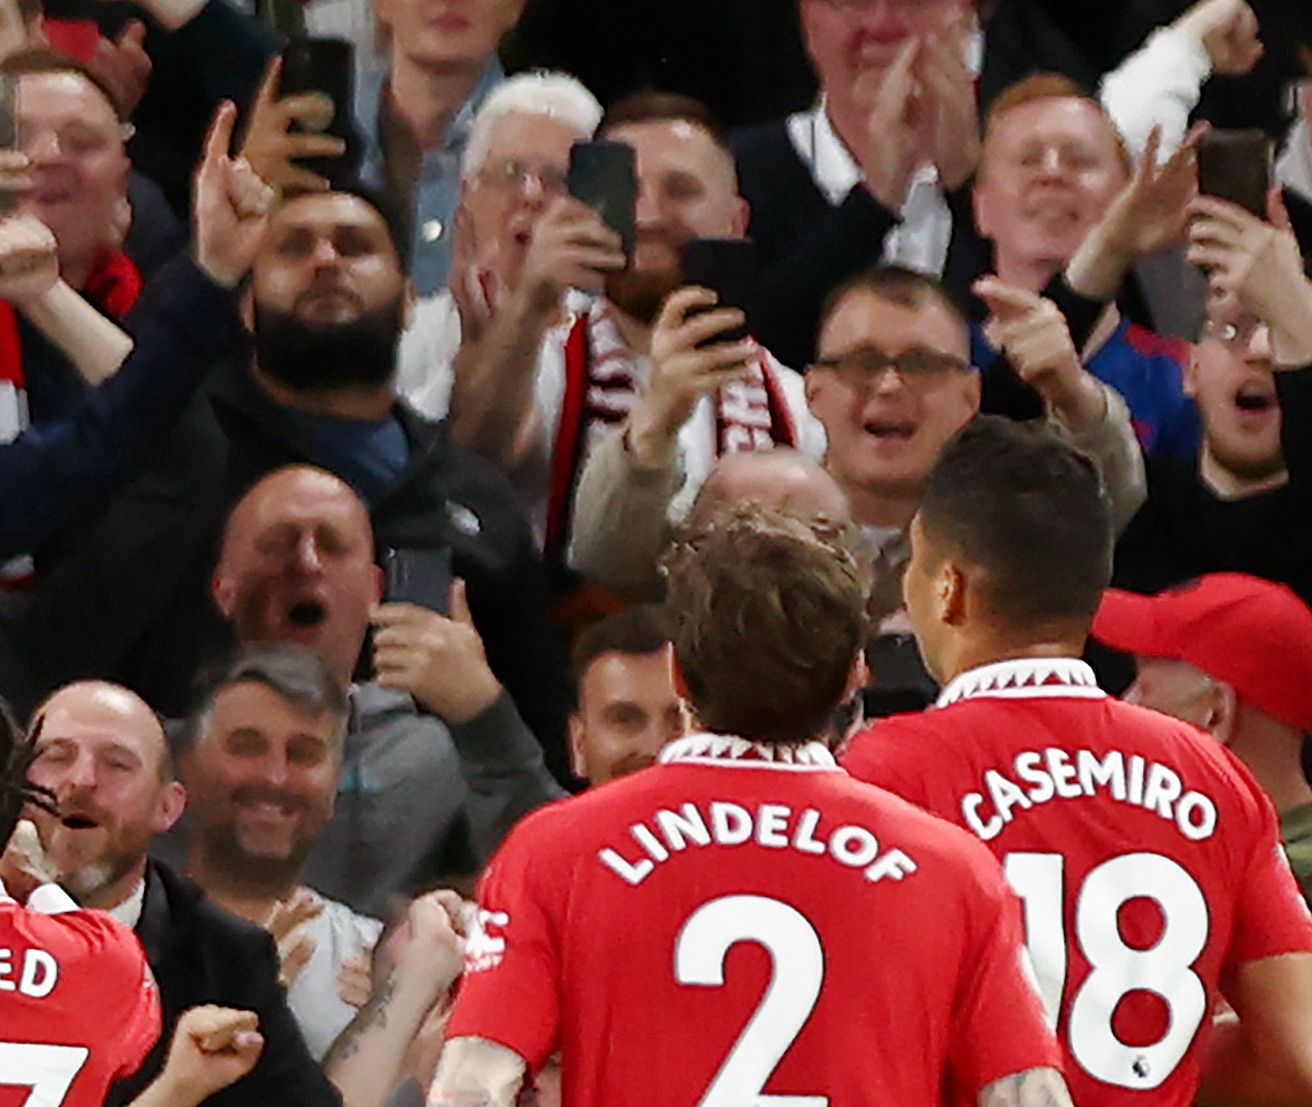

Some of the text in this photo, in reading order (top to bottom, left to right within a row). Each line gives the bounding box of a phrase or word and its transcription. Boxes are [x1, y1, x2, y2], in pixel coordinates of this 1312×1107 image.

[961, 747, 1218, 842] CASEMIRO
[598, 801, 918, 885] LINDELOF
[1004, 851, 1212, 1091] 18
